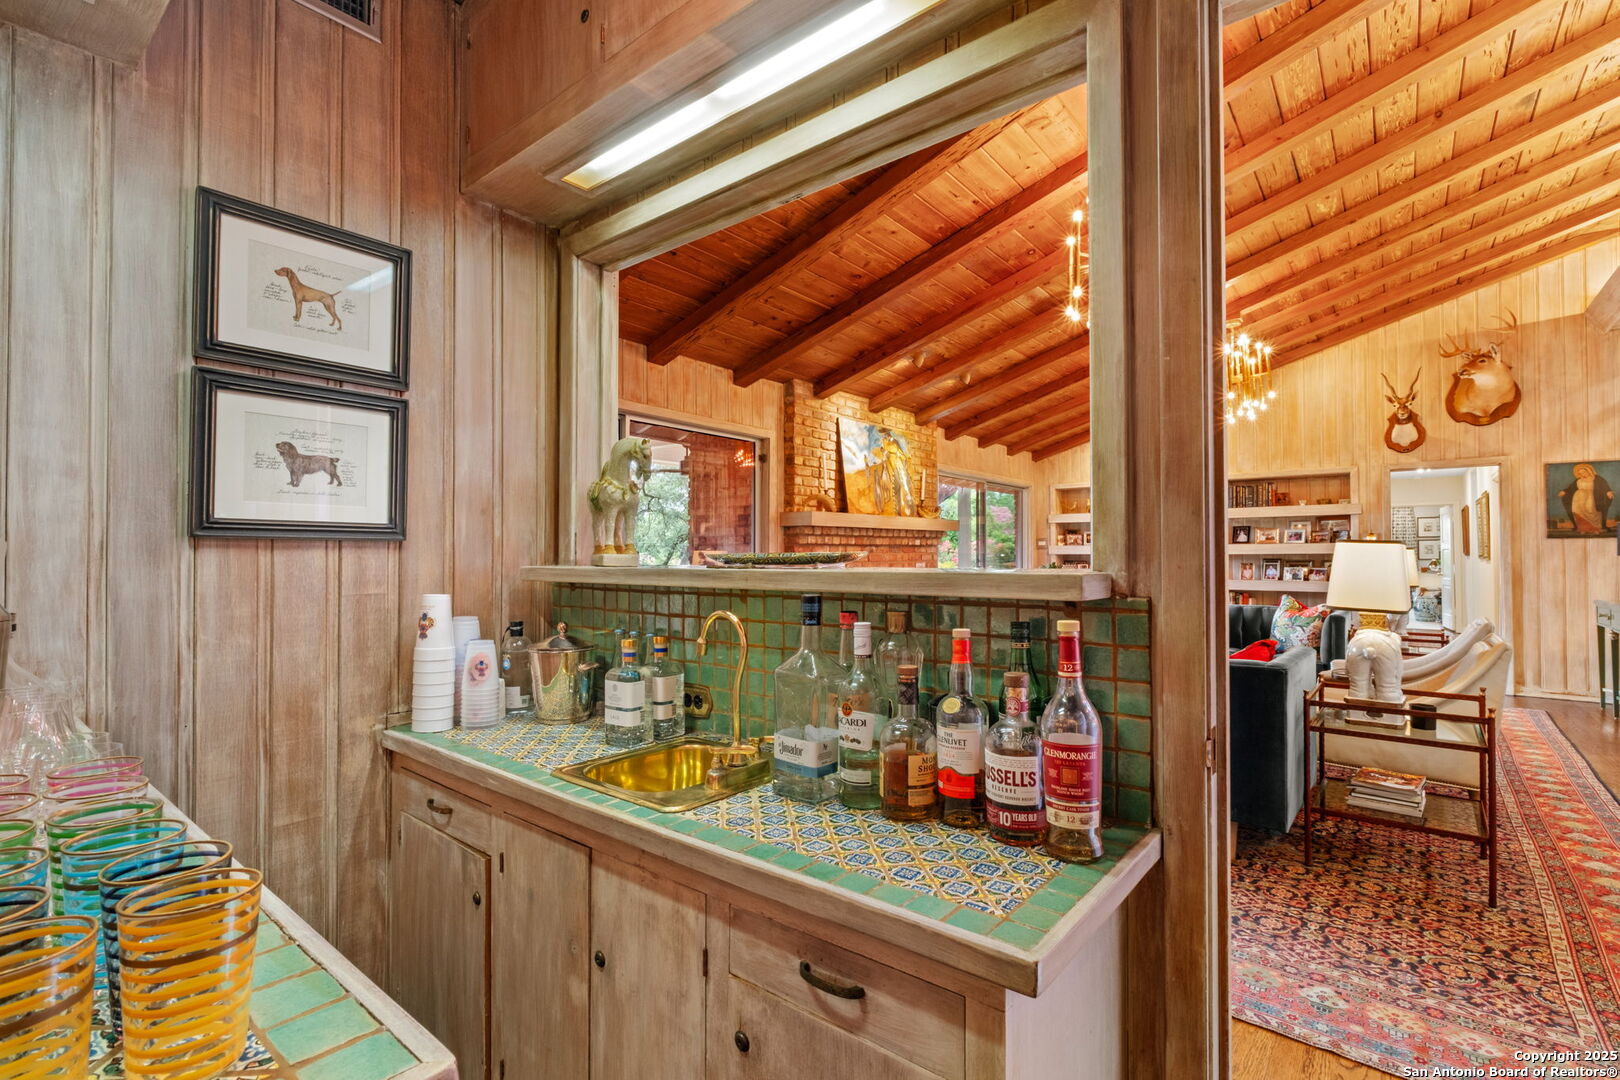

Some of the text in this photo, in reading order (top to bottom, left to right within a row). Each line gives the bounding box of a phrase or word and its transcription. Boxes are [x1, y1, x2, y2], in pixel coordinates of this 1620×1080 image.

[839, 716, 867, 728] CARDI
[1043, 746, 1097, 761] GLENMORANGIE
[985, 765, 1037, 788] USSELL'S
[998, 811, 1011, 827] 10
[1012, 813, 1028, 822] YEARS
[1028, 813, 1037, 822] OLD
[1066, 815, 1076, 824] 12
